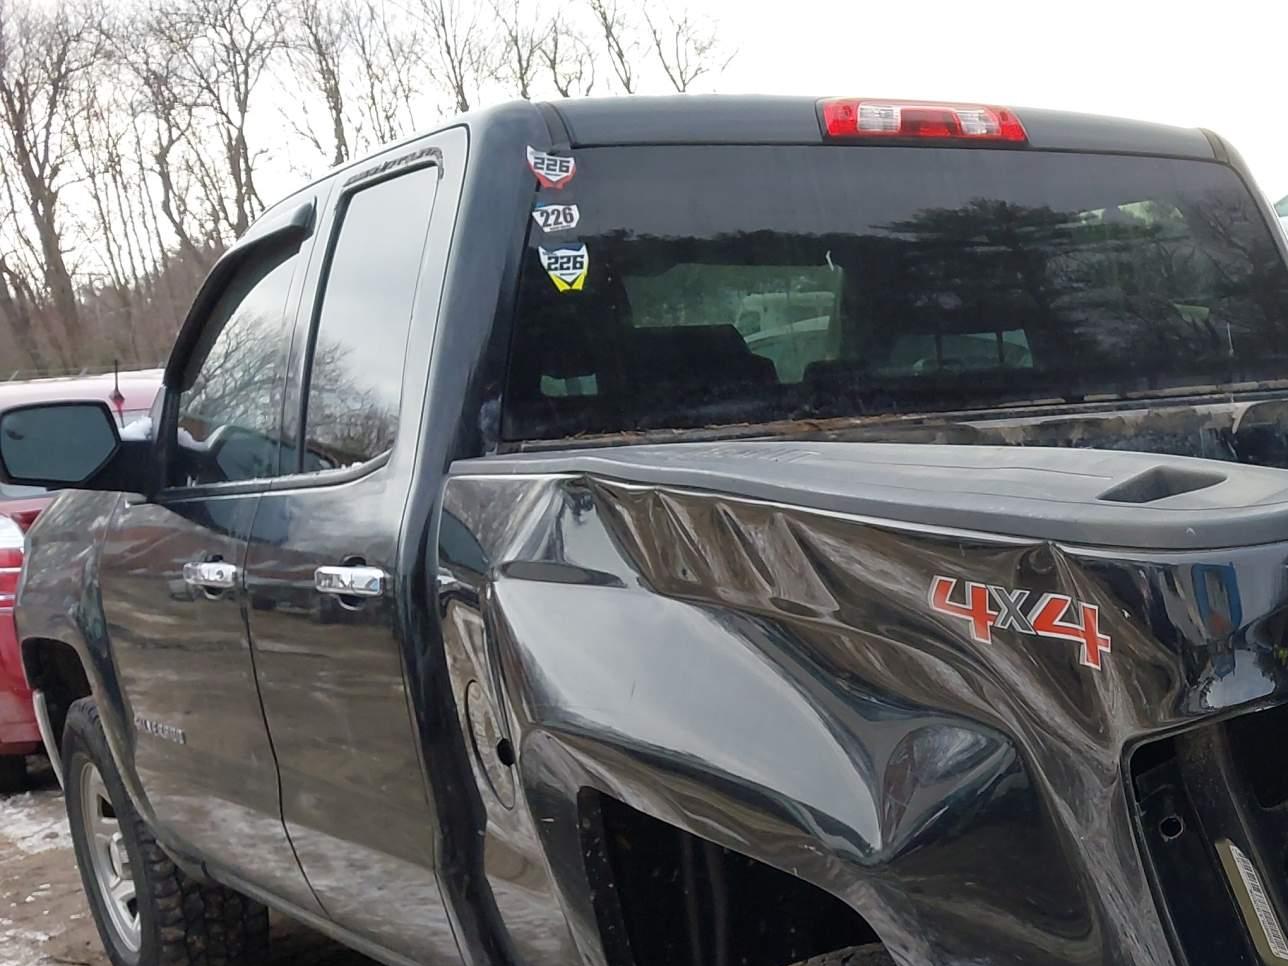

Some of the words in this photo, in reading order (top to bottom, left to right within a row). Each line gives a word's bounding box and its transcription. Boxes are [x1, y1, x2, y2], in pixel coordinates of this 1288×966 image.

[532, 156, 571, 173] 226
[540, 206, 575, 228] 226
[546, 254, 585, 272] 226
